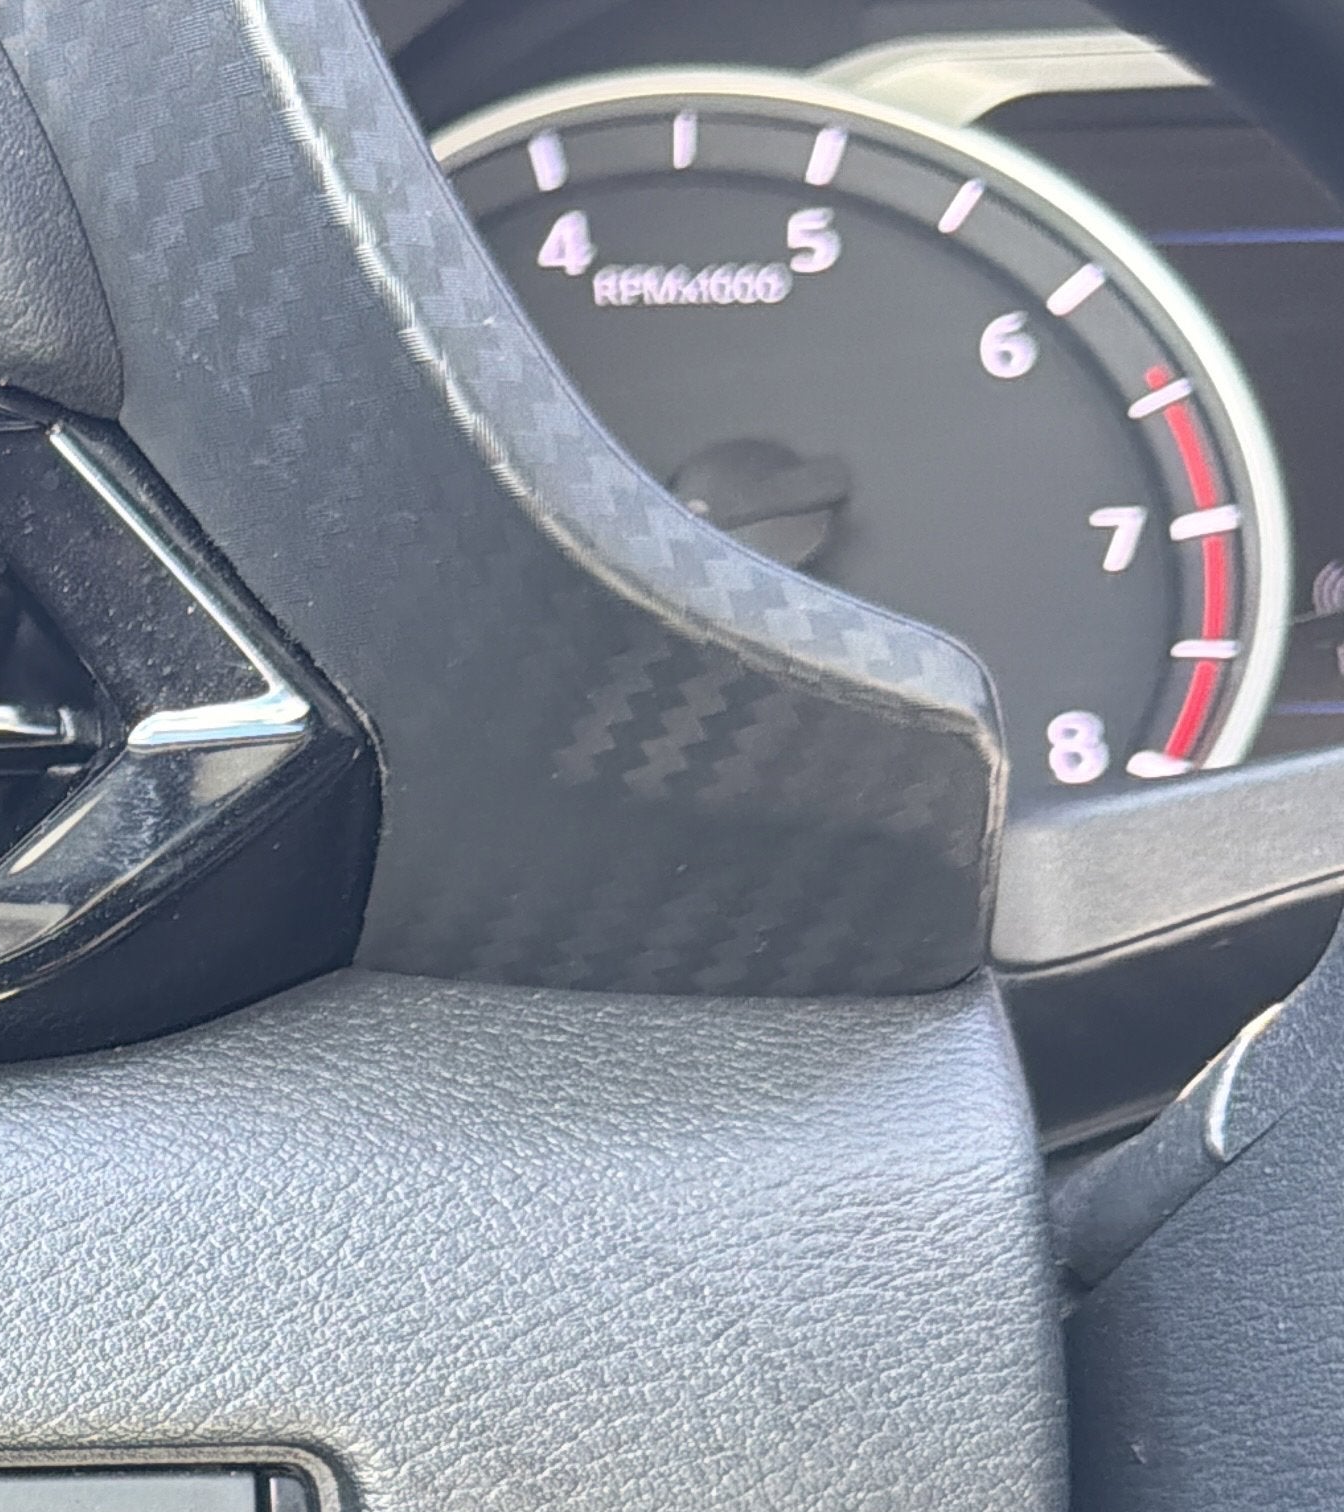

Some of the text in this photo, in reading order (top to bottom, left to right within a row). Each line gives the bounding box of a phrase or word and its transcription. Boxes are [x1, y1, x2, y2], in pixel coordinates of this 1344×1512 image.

[537, 210, 596, 275] 4
[786, 207, 841, 273] 5
[979, 311, 1039, 378] 6
[1089, 506, 1147, 572] 7
[1046, 710, 1109, 784] 8
